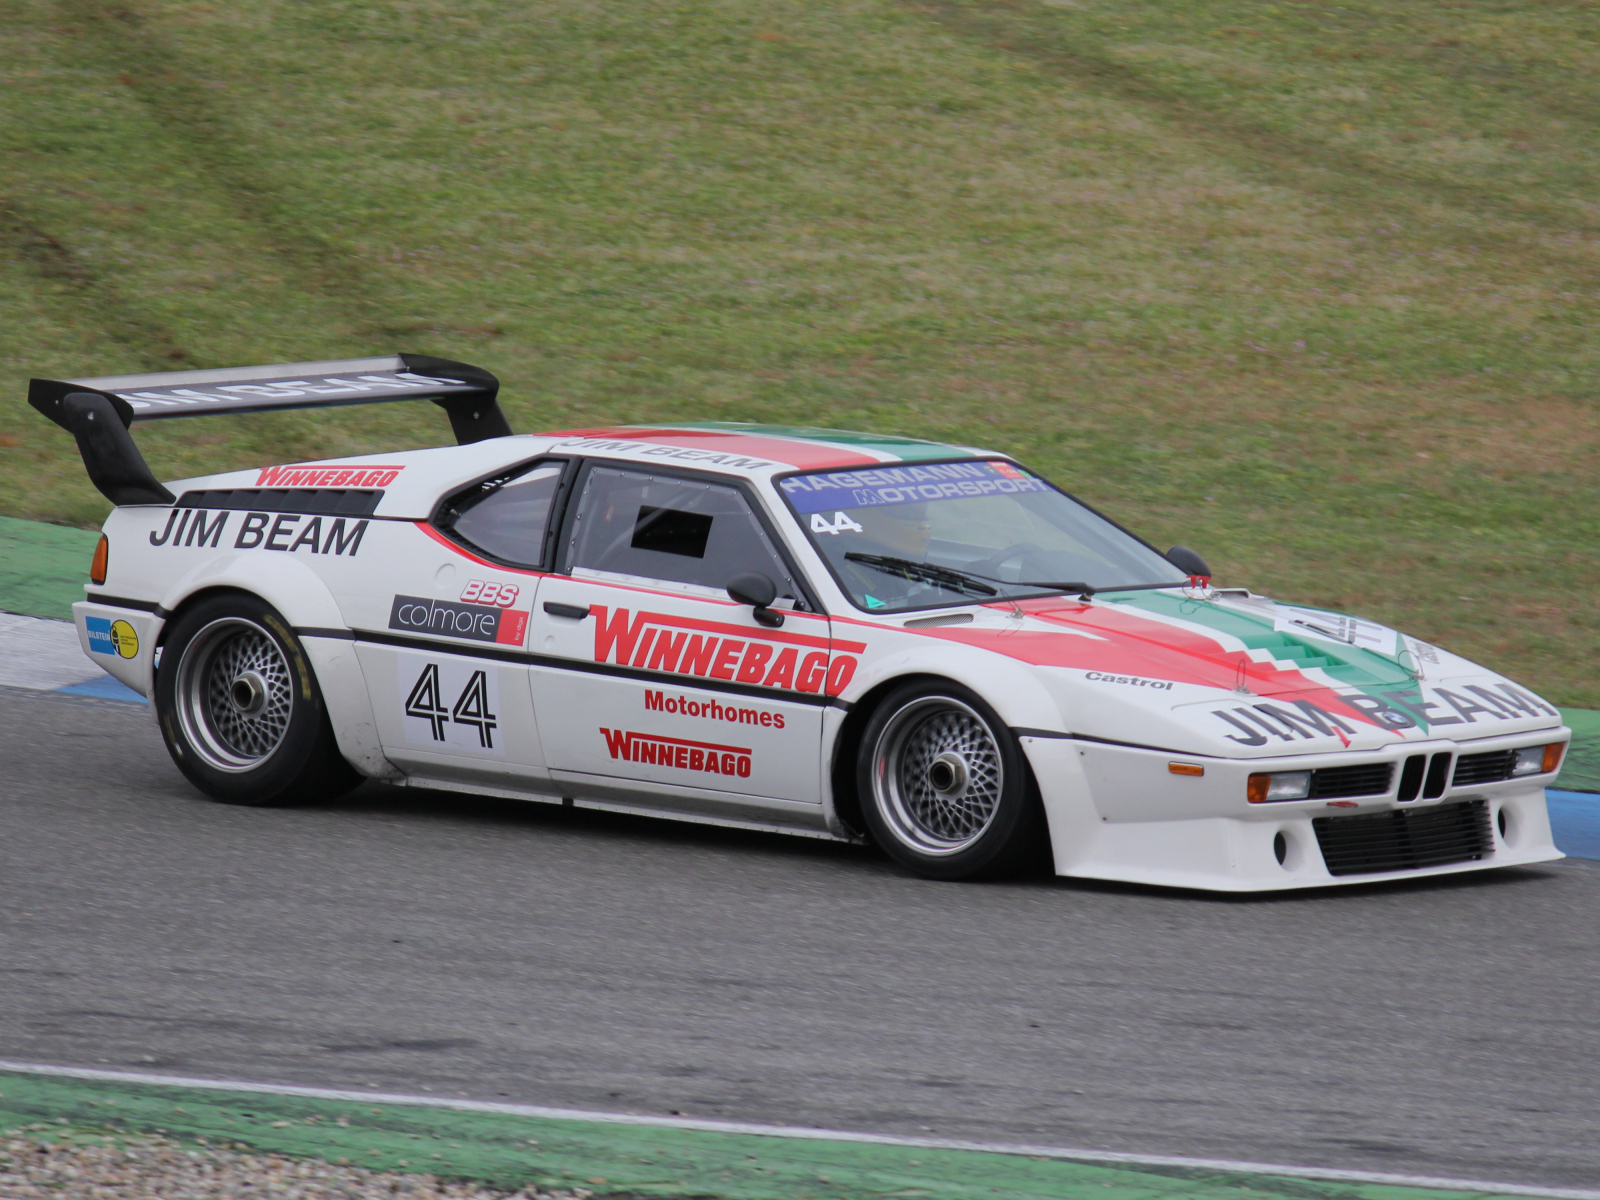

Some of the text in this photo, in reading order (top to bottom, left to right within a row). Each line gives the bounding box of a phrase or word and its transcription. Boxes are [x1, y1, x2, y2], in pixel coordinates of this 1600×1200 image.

[215, 373, 466, 398] BEAM
[561, 438, 776, 470] JIM BEAM
[255, 465, 406, 488] WINNEBAGO
[780, 463, 986, 493] HAGEMANN
[853, 477, 1048, 505] MOTORSPORT
[149, 508, 370, 557] JIM BEAM
[811, 511, 863, 535] 44
[460, 579, 519, 608] BBS
[398, 599, 495, 635] colmore
[589, 604, 867, 697] WINNEBAGO
[1085, 671, 1174, 691] Castrol
[405, 663, 497, 749] 44
[644, 689, 785, 730] Motorhomes
[1210, 683, 1558, 747] JIM BEAM
[599, 727, 752, 778] WINNEBAGO
